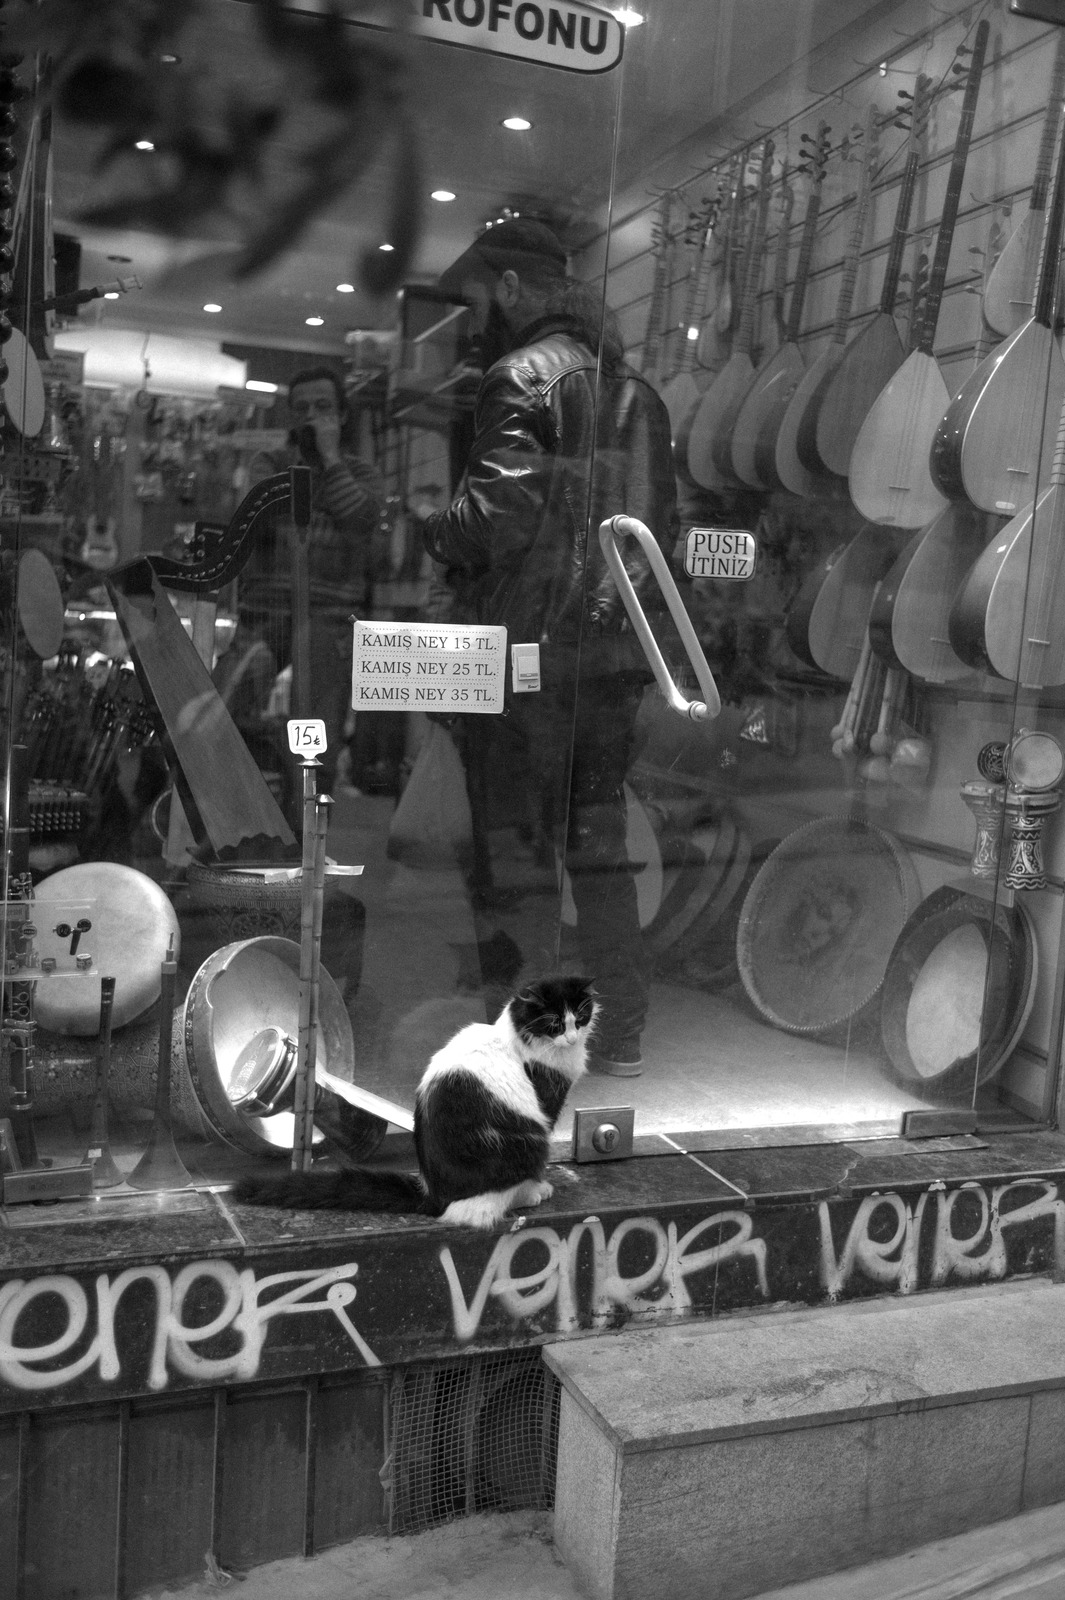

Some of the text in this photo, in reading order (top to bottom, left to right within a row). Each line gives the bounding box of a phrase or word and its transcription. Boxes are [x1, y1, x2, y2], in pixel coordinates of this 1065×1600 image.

[693, 533, 748, 555] PUSH
[691, 553, 748, 576] İTİNİZ
[362, 634, 497, 650] KAMIŞ NEY 15 TL.
[361, 661, 496, 677] KAMIŞ NEY 25 TL.
[360, 687, 495, 703] KAMIŞ NEY 35 TL.
